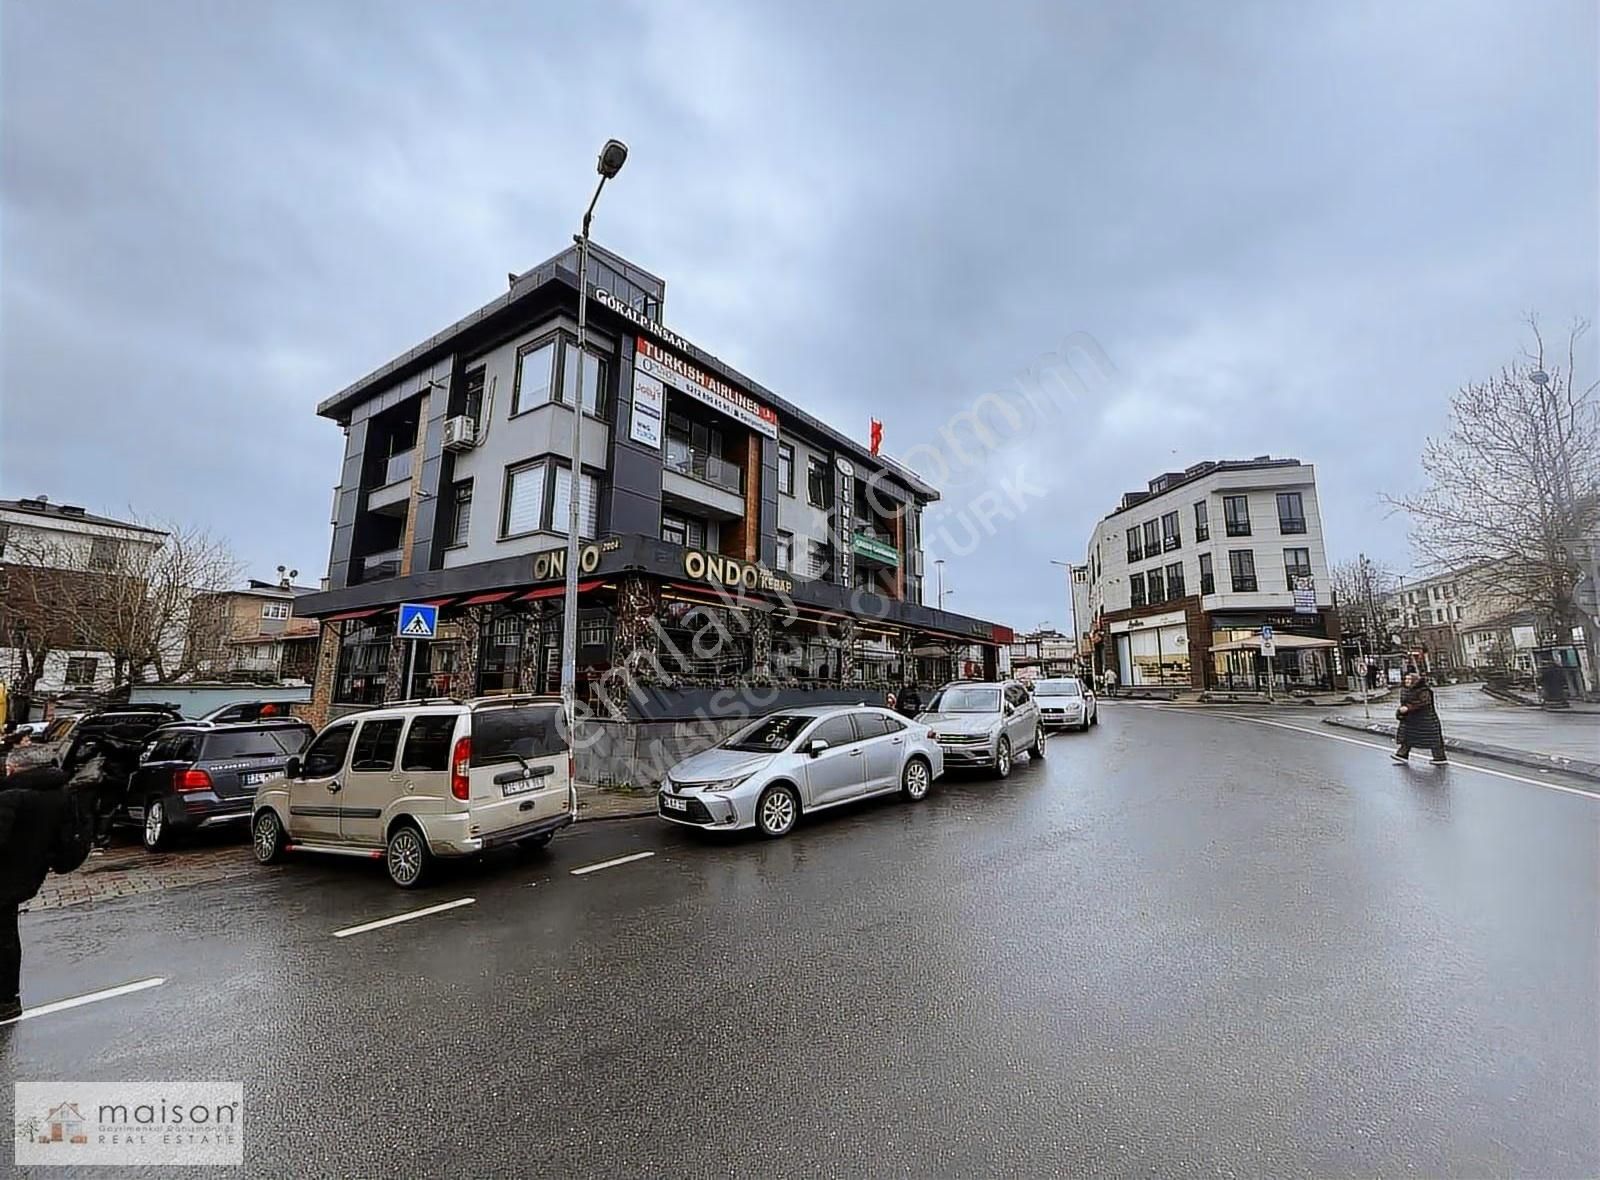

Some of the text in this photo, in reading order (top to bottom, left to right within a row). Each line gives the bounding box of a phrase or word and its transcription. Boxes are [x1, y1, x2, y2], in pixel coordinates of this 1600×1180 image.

[643, 340, 705, 386] TURKISH
[708, 377, 760, 416] AIRLINES
[533, 544, 599, 580] ONO
[685, 551, 758, 589] ONDO
